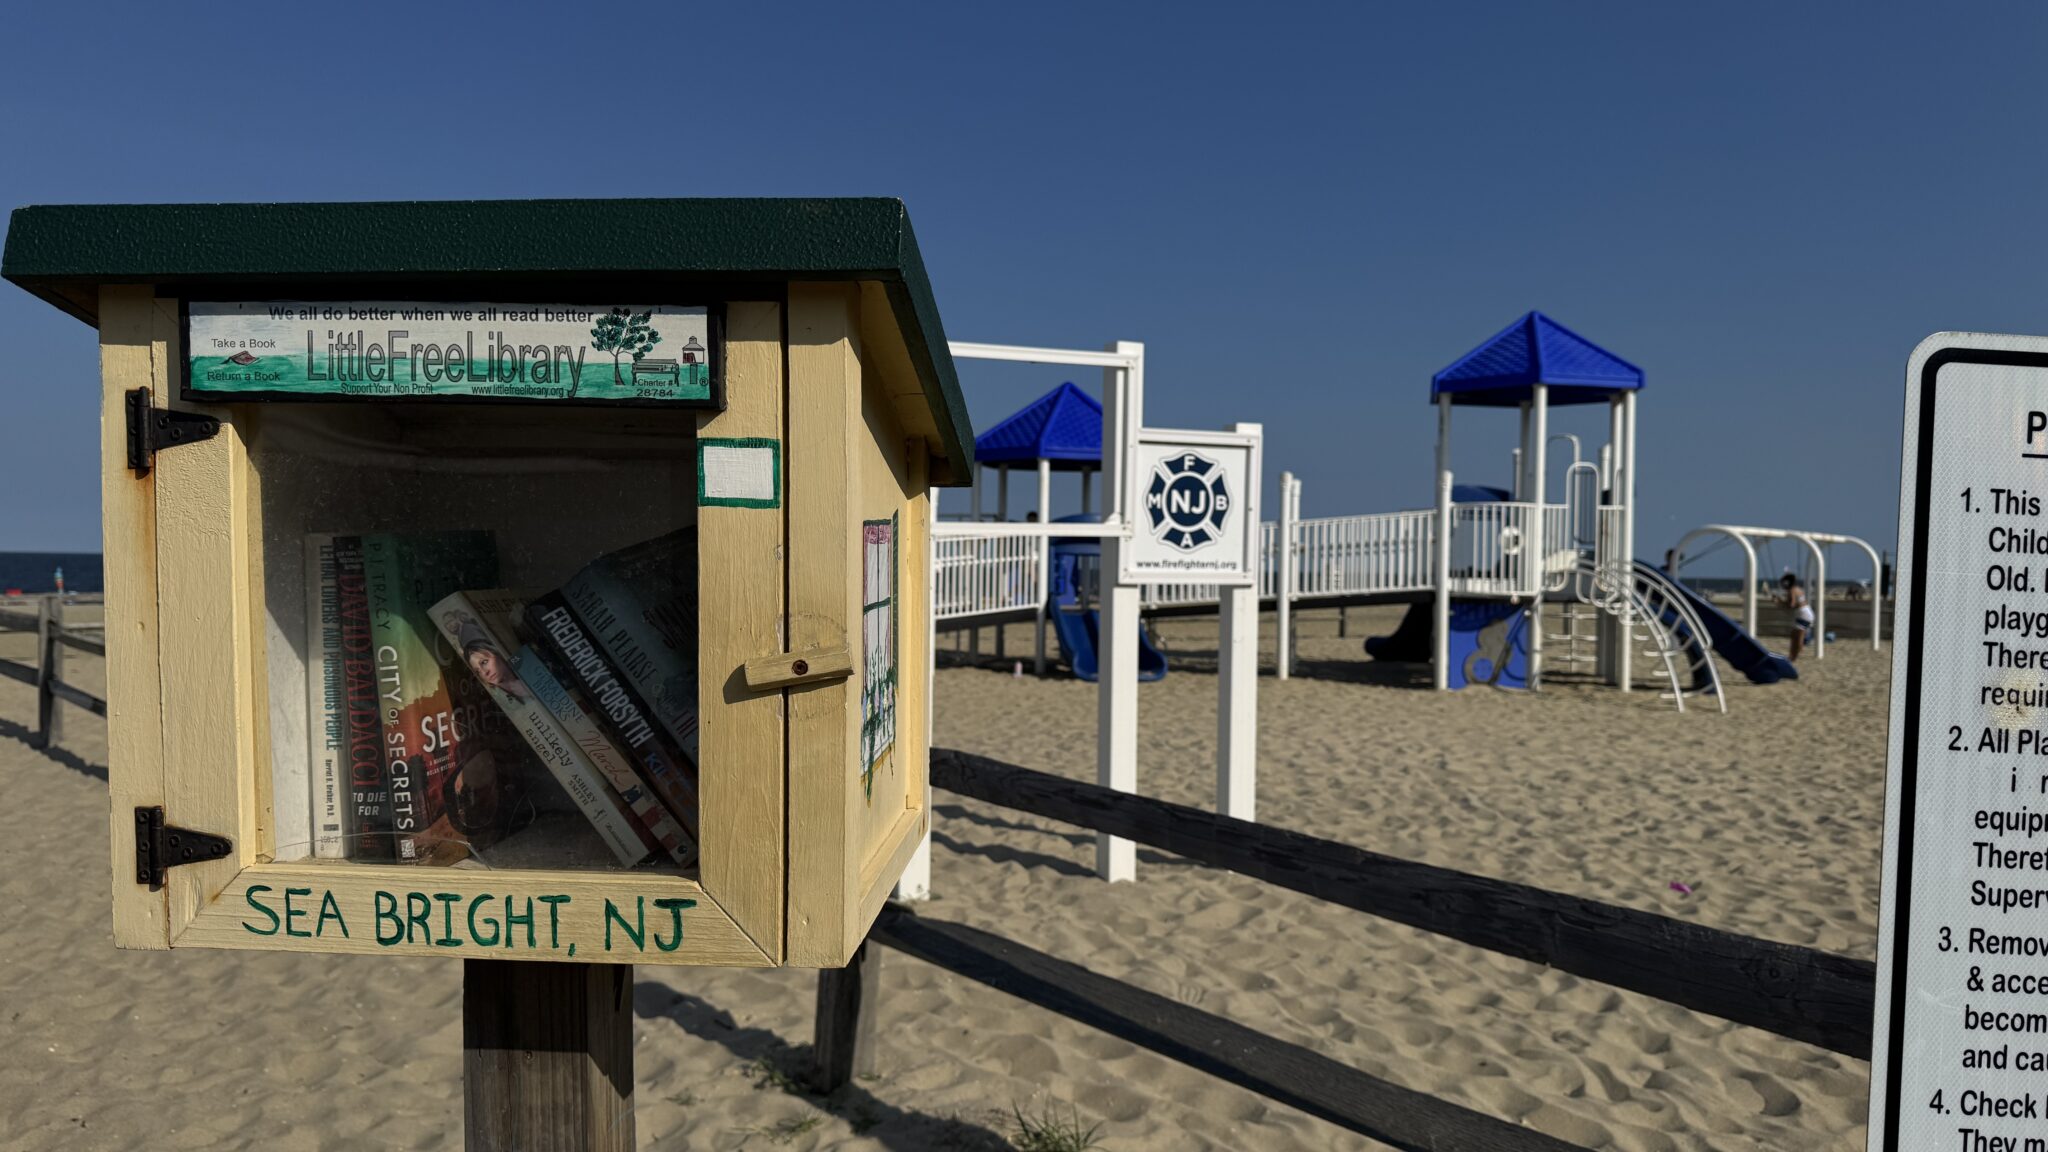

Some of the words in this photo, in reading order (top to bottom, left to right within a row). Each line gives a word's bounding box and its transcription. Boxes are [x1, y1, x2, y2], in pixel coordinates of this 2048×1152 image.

[268, 306, 294, 321] We
[300, 306, 317, 321] all
[323, 306, 343, 321] do
[349, 306, 396, 321] better
[400, 307, 444, 321] when
[450, 309, 472, 321] we
[478, 307, 497, 321] all
[503, 308, 538, 322] read
[545, 309, 593, 323] better
[211, 338, 236, 349] Take
[239, 340, 246, 349] a
[249, 338, 276, 349] Book
[207, 371, 242, 381] Return
[244, 373, 251, 381] a
[254, 371, 281, 381] Book
[308, 329, 586, 398] LittleFreeLibrary
[341, 382, 373, 395] Support
[374, 384, 392, 394] Your
[393, 383, 410, 394] Non
[412, 383, 433, 394] Profit
[472, 384, 564, 397] www.littlefreelibrary.org
[637, 378, 666, 387] Charter
[2027, 410, 2047, 444] P
[1183, 455, 1196, 471] F
[1148, 493, 1162, 509] M
[1171, 489, 1206, 514] NJ
[1215, 495, 1228, 511] B
[1961, 487, 1980, 513] 1.
[1990, 488, 2040, 516] This
[1180, 533, 1194, 548] A
[1987, 565, 2035, 592] Old.
[321, 585, 338, 623] LOVERS
[339, 574, 372, 653] DAVID
[372, 573, 391, 630] TRACY
[322, 628, 340, 648] AND
[571, 583, 616, 632] SARAH
[608, 629, 658, 686] PEARSE
[323, 652, 341, 710] POISONOUS
[378, 645, 402, 703] CITY
[541, 605, 612, 688] FREDERICK
[593, 678, 655, 749] FORSYTH
[532, 680, 571, 722] BROOKS
[535, 666, 586, 723] GERALDINE
[1981, 683, 2048, 711] requi
[325, 713, 343, 750] PEOPLE
[345, 659, 381, 787] BALDACCI
[388, 707, 400, 727] OF
[526, 728, 556, 763] angel
[529, 711, 573, 767] unlikely
[1947, 725, 1969, 751] 2.
[1978, 727, 2009, 753] All
[579, 731, 630, 787] March
[388, 732, 414, 830] SECRETS
[568, 780, 590, 806] SMITH
[572, 774, 598, 803] ASHLEY
[352, 792, 363, 802] TO
[367, 791, 387, 802] DIE
[358, 805, 380, 816] FOR
[1975, 806, 2048, 838] equip
[1971, 880, 2048, 914] Super
[242, 885, 349, 938] SEA
[375, 890, 576, 957] BRIGHT,
[605, 896, 697, 952] NJ
[1938, 926, 1958, 952] 3.
[1967, 966, 1984, 992] &
[1965, 1004, 2047, 1033] becom
[1963, 1044, 2007, 1070] and
[2016, 1051, 2048, 1071] ca
[1929, 1088, 1950, 1115] 4.
[1960, 1090, 2037, 1119] Check
[1958, 1128, 2017, 1152] They
